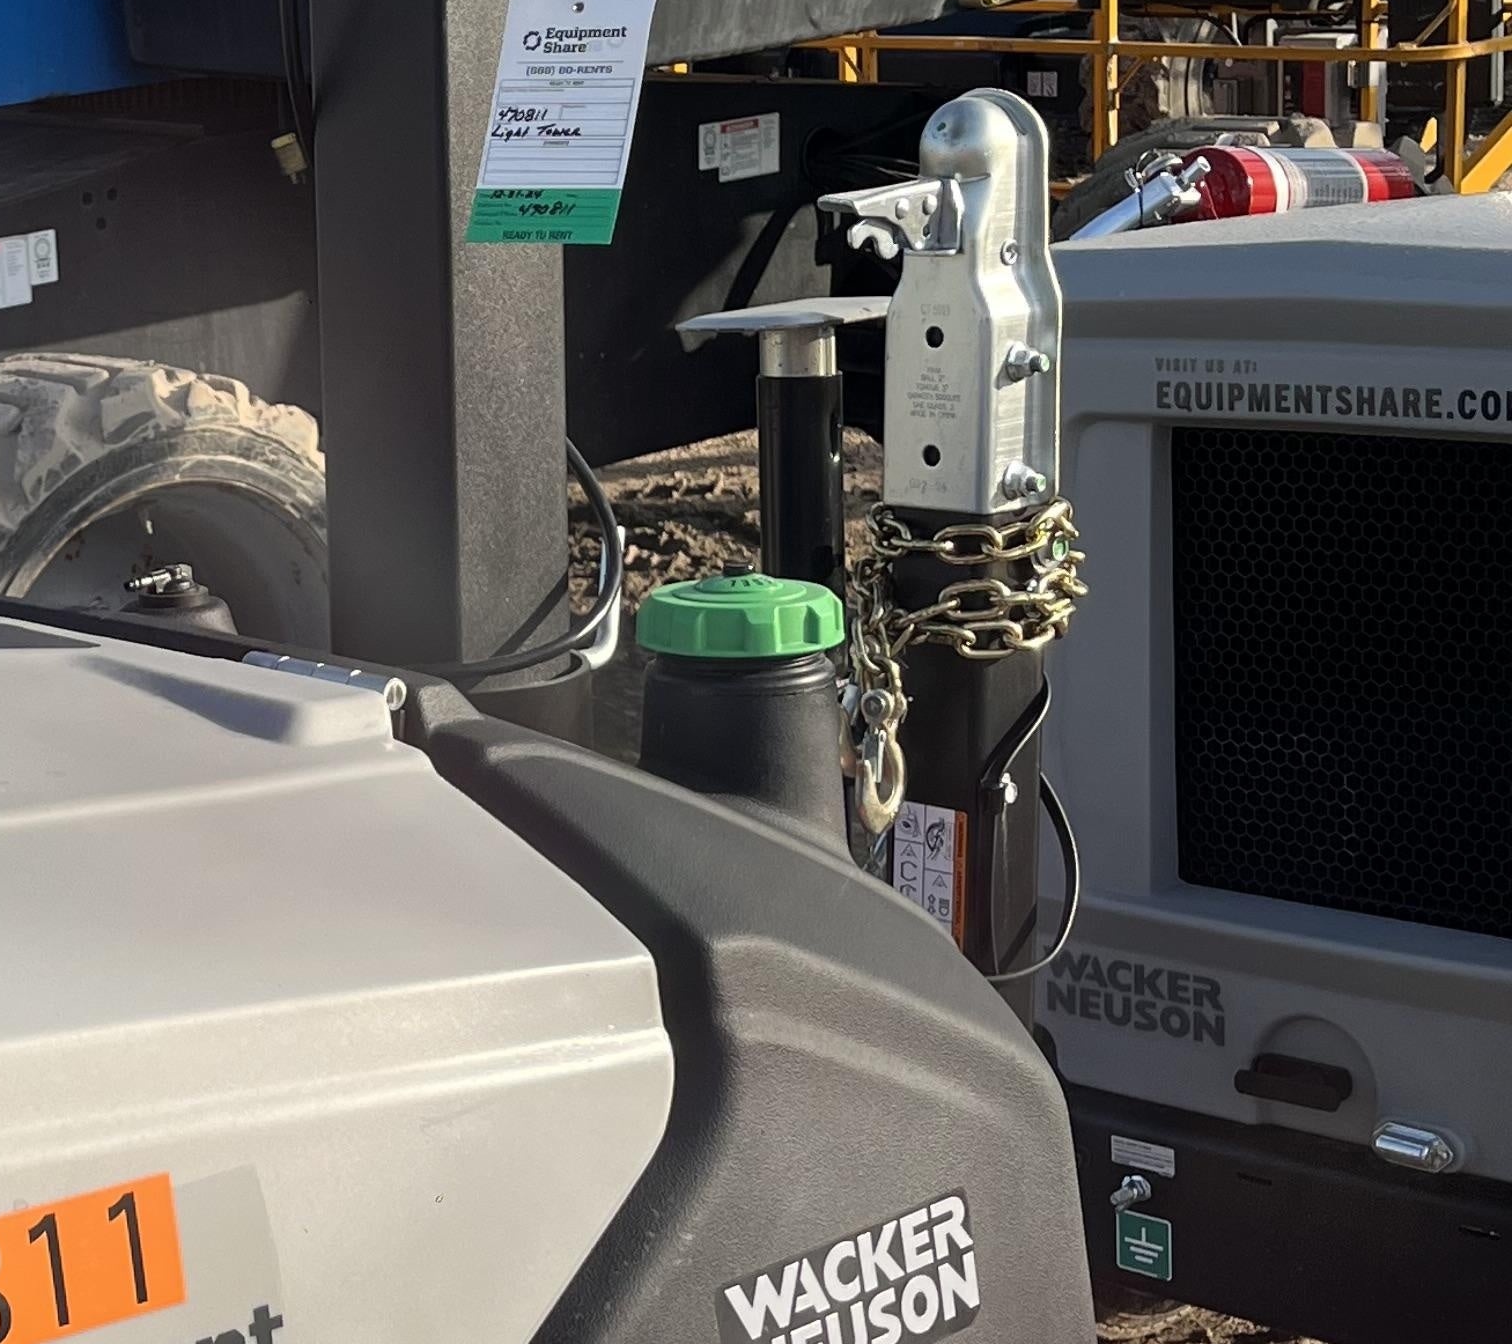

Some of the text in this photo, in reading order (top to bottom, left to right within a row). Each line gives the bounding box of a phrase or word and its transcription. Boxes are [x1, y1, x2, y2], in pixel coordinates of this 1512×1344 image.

[543, 41, 587, 53] Share
[545, 27, 627, 42] Equipment
[1155, 357, 1197, 373] VISIT
[1205, 359, 1225, 374] US
[1155, 381, 1512, 421] EQUIPMENTSHARE.CO
[1044, 946, 1225, 1012] WACKER
[1046, 980, 1225, 1047] NEUSON
[724, 1196, 974, 1340] WACKER
